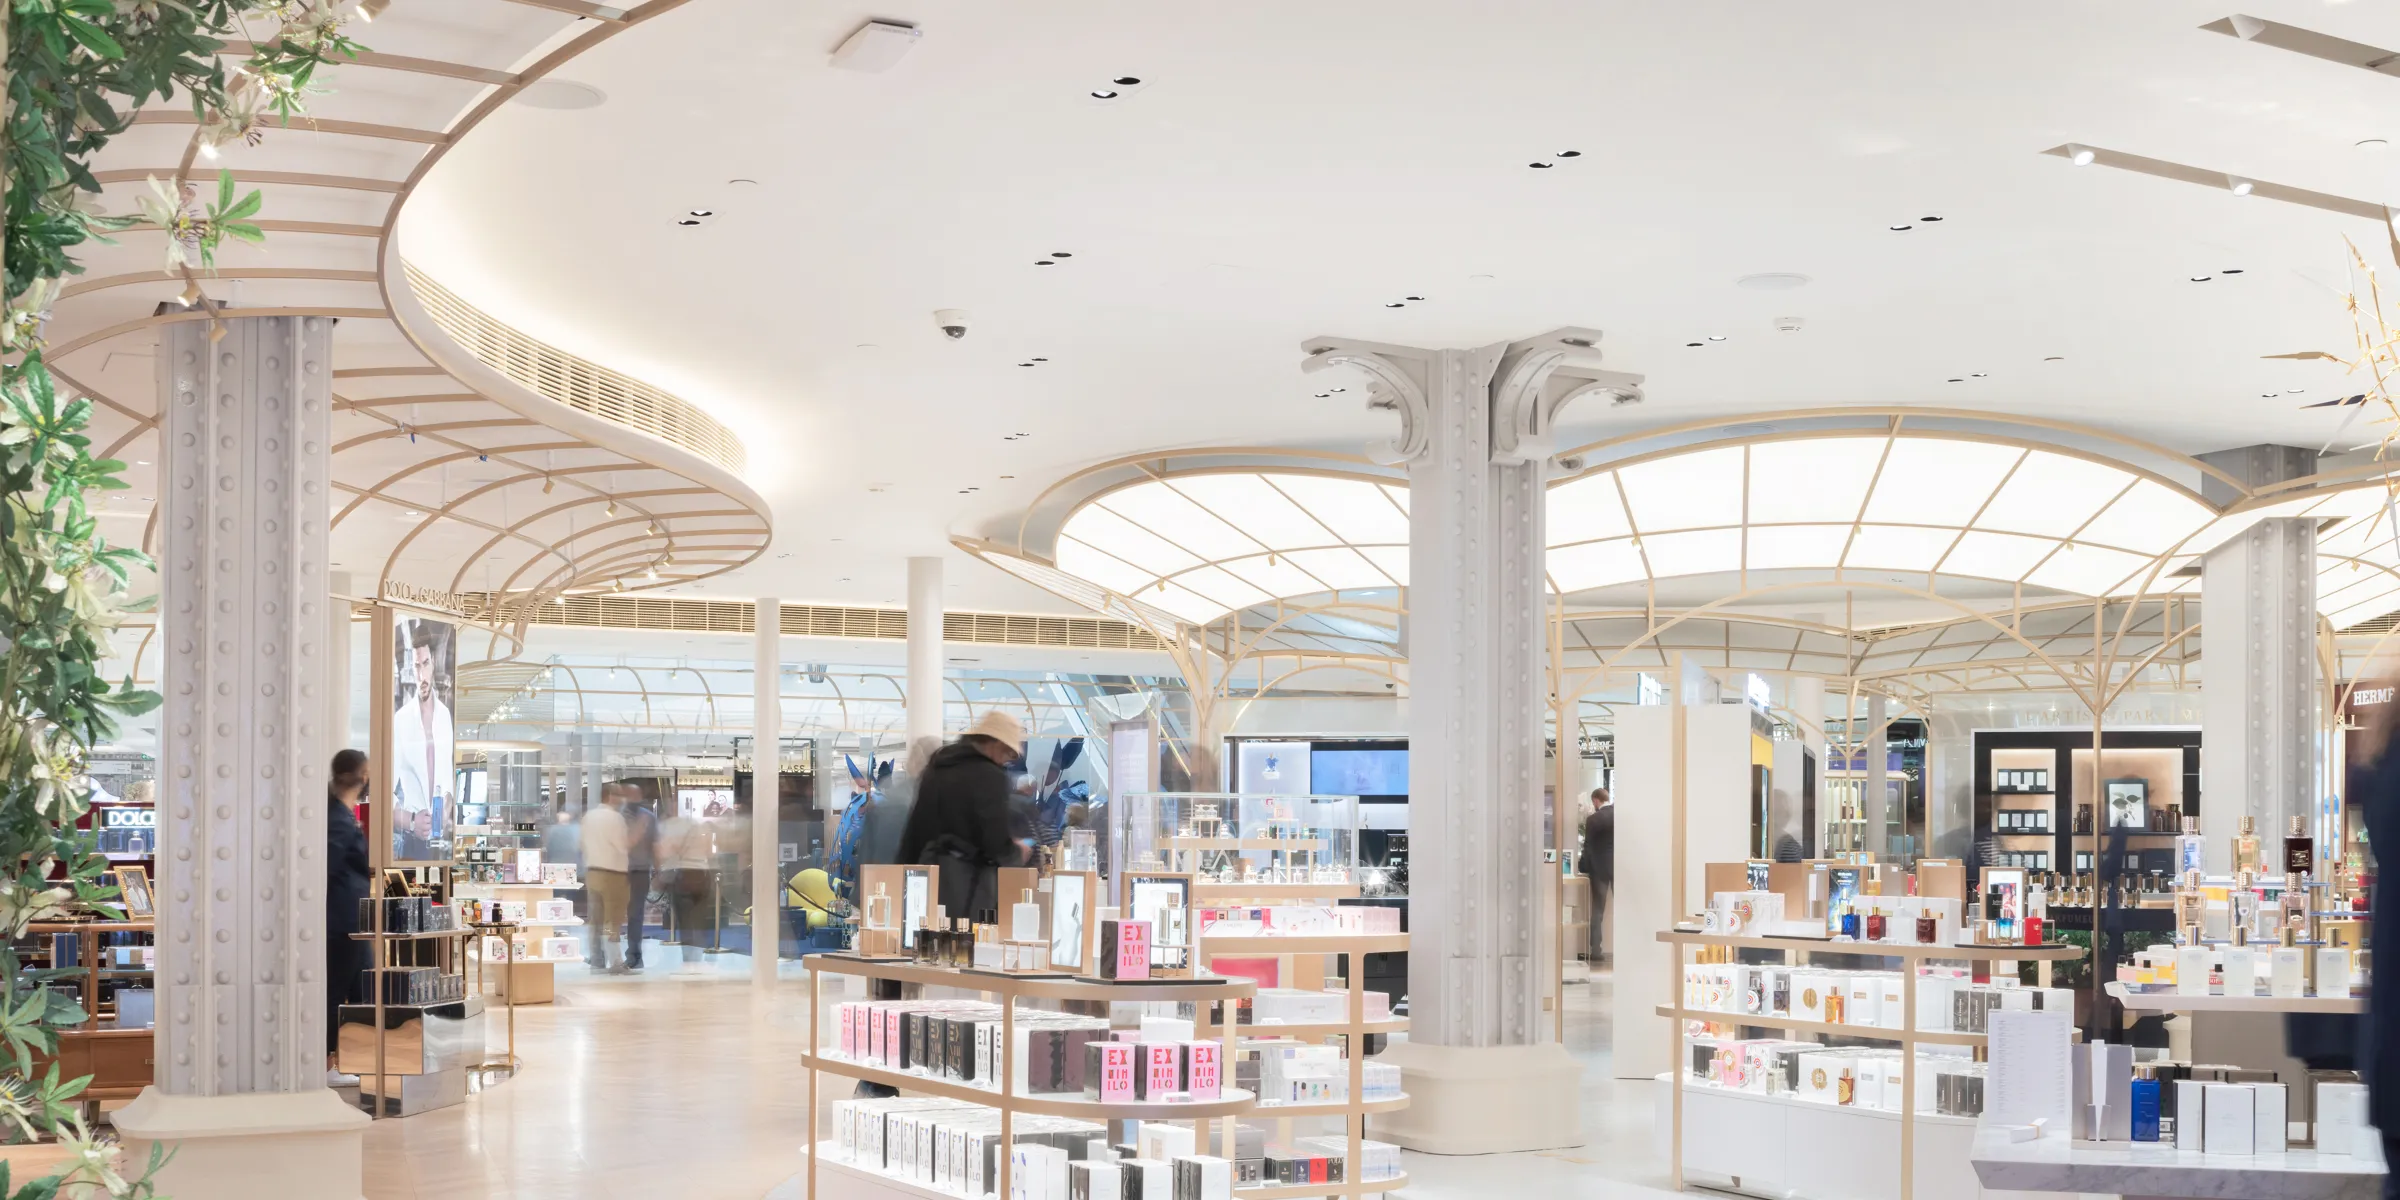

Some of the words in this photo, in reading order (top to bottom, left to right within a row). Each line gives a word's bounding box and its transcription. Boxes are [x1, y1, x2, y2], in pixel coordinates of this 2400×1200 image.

[108, 810, 156, 826] DOLC
[1124, 925, 1144, 941] EX
[1123, 956, 1144, 967] ILO
[977, 1028, 988, 1046] EX
[1108, 1049, 1128, 1066] EX
[1153, 1048, 1173, 1065] EX
[1195, 1047, 1214, 1064] EX
[1107, 1080, 1128, 1091] ILO
[1152, 1079, 1173, 1090] ILO
[1194, 1078, 1214, 1089] ILO
